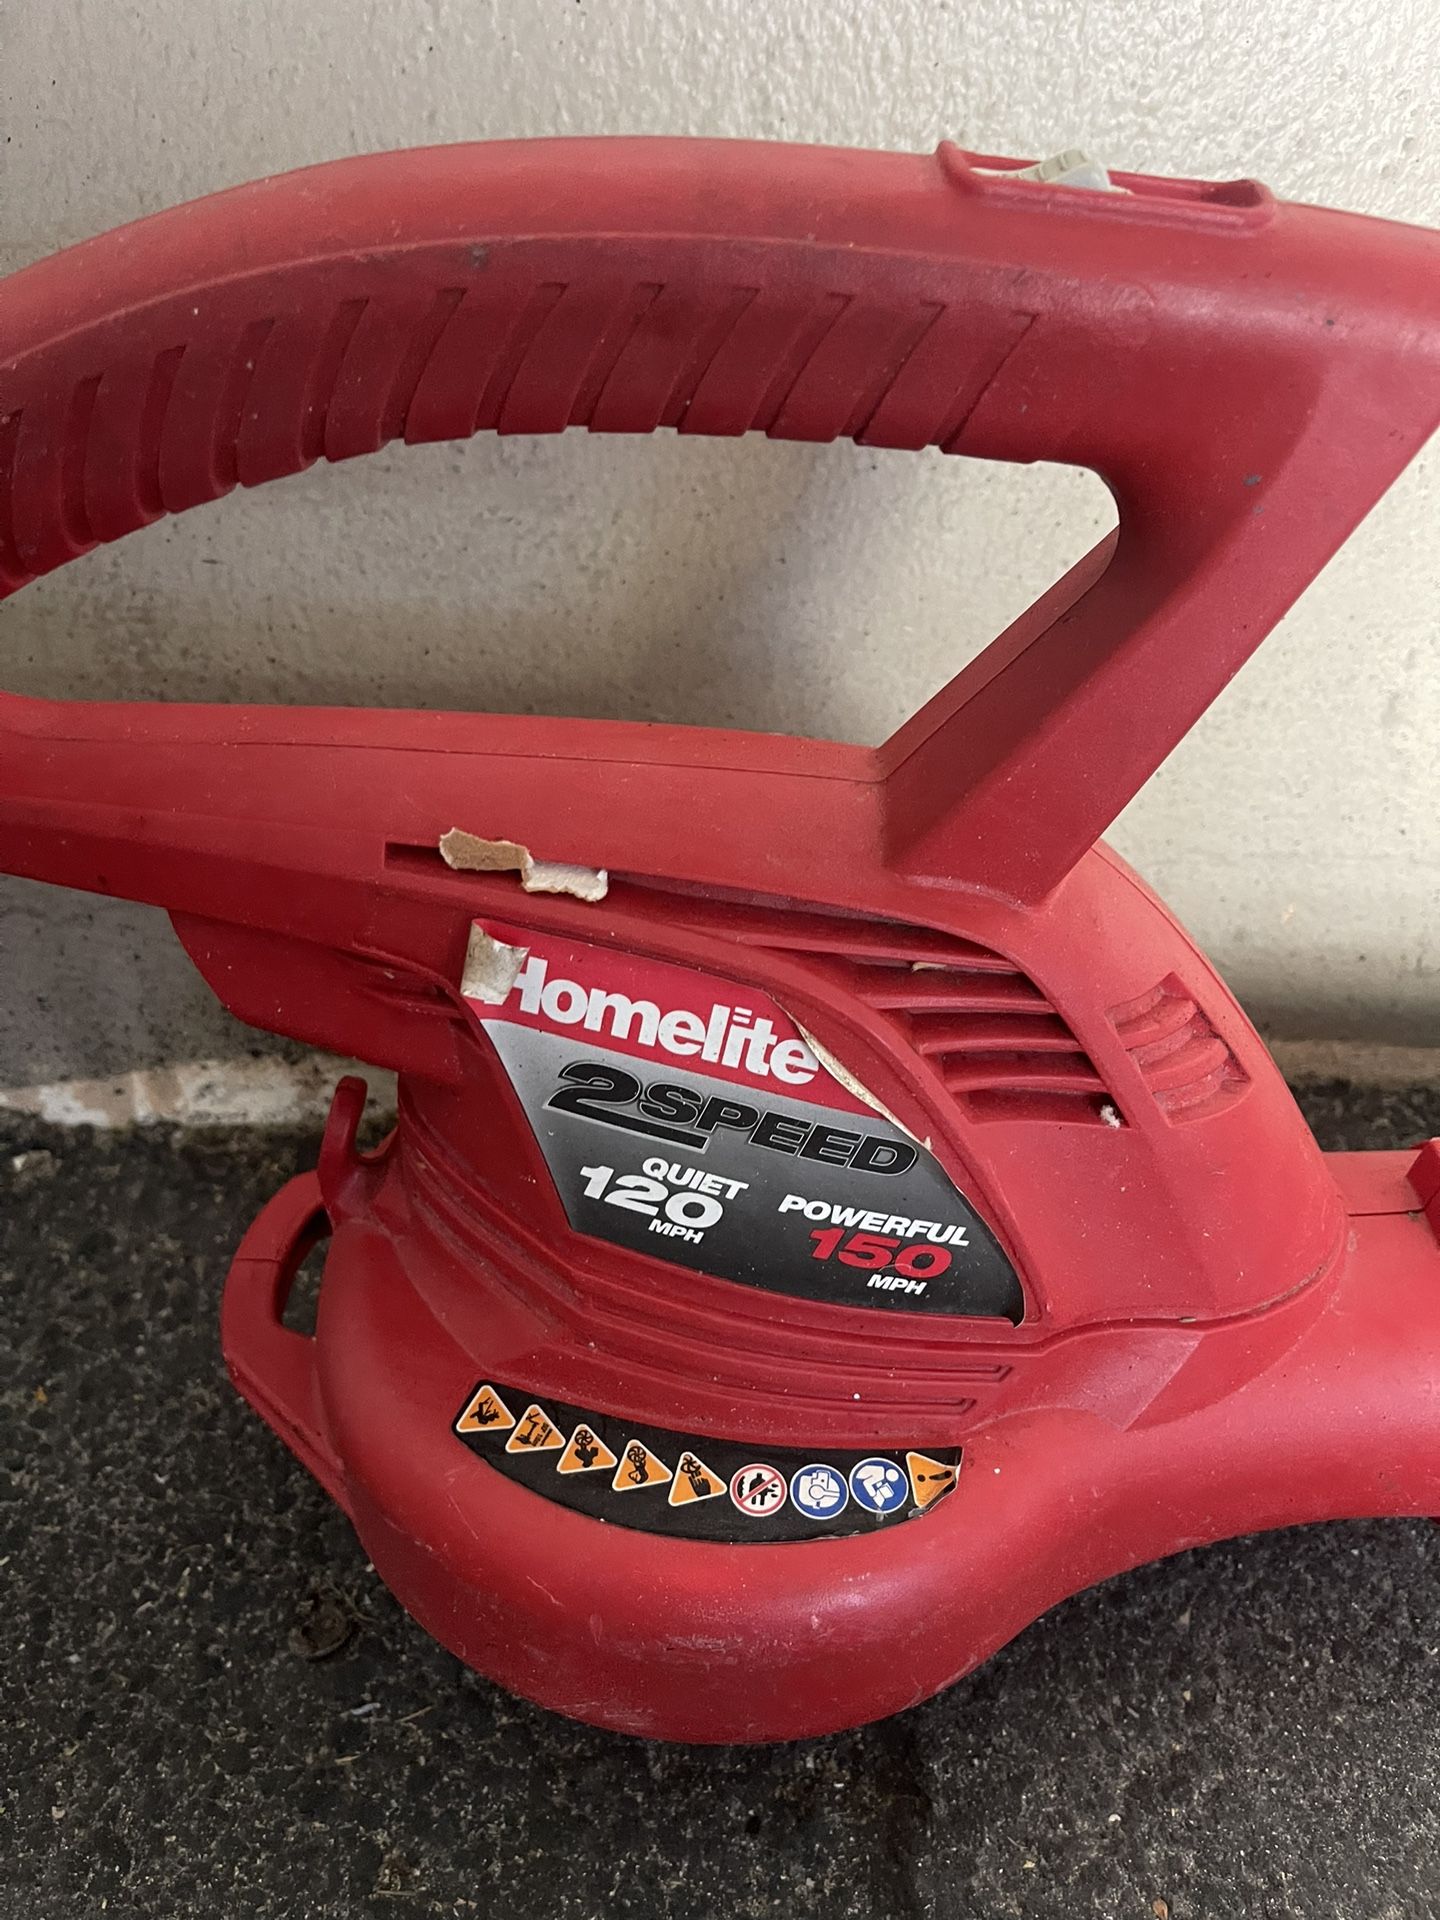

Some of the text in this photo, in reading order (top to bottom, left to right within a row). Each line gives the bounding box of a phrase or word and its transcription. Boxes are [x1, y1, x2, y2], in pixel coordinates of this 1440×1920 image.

[579, 1164, 723, 1229] 120
[642, 1157, 748, 1199] QUIET
[648, 1217, 704, 1244] MPH
[778, 1194, 970, 1246] POWERFUL
[810, 1228, 952, 1278] 150
[867, 1273, 926, 1295] MPH
